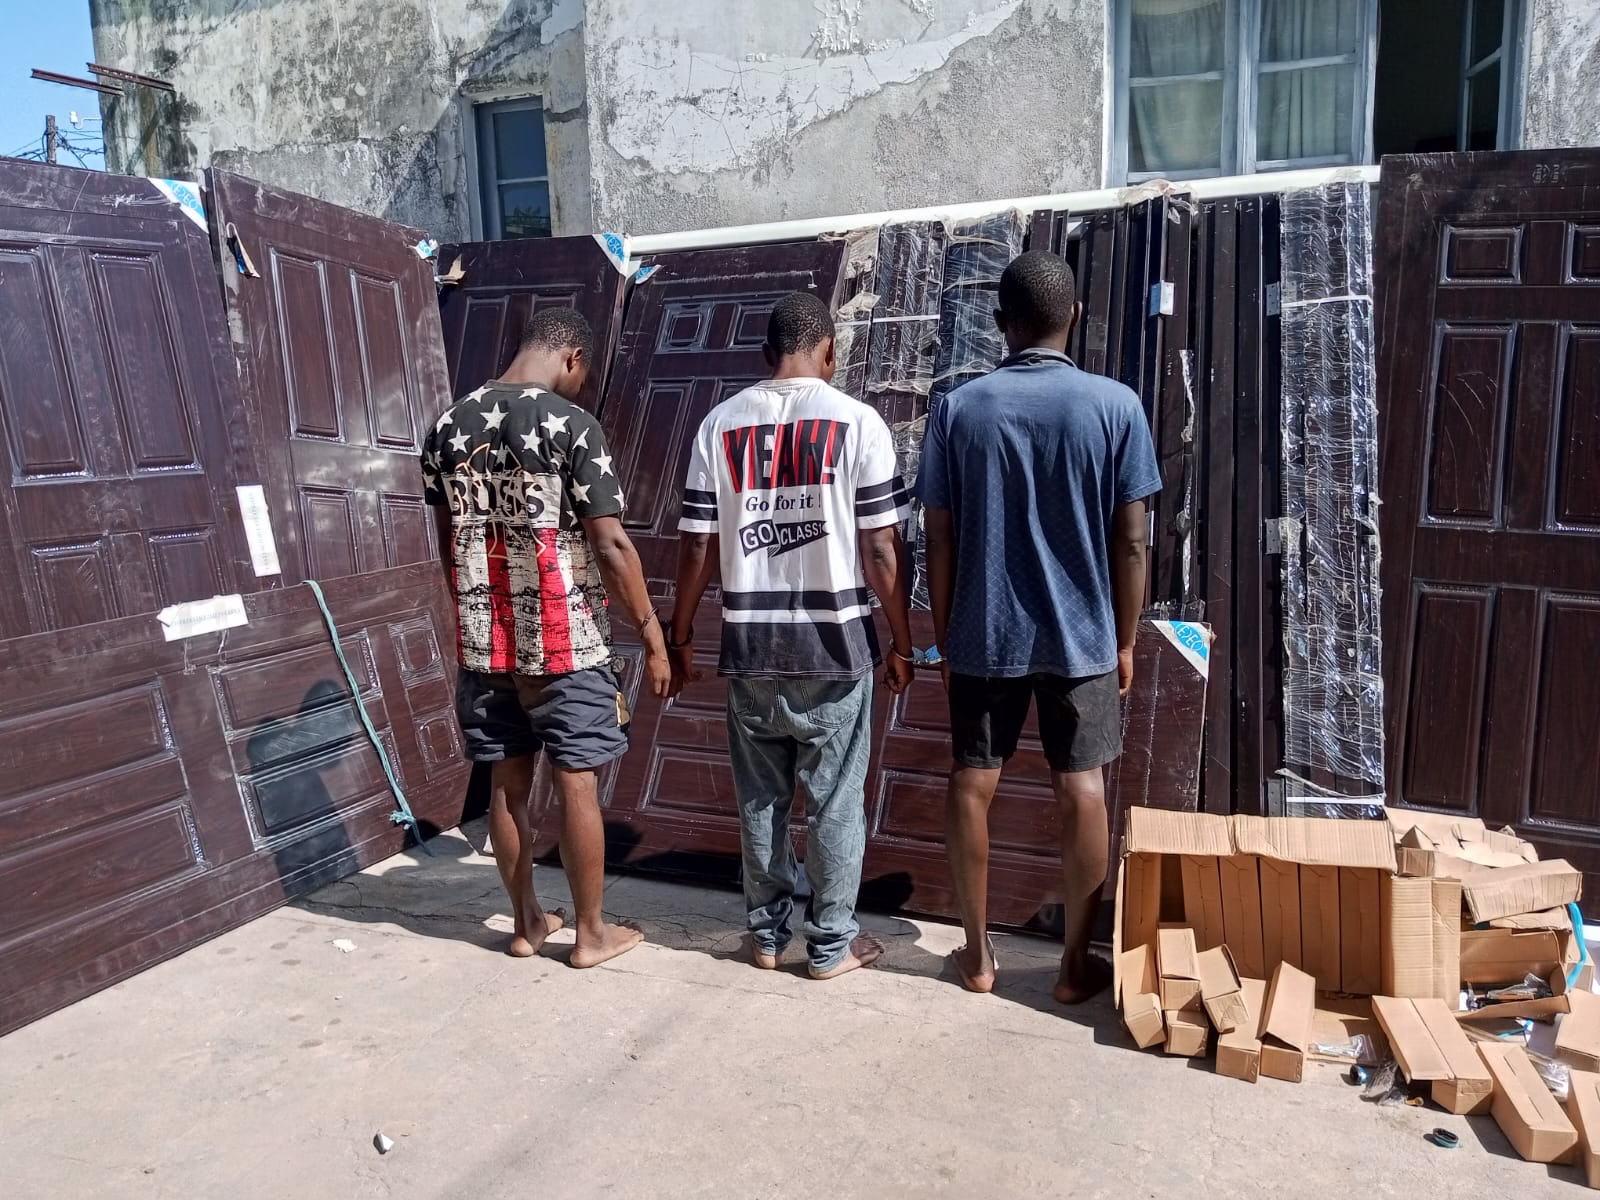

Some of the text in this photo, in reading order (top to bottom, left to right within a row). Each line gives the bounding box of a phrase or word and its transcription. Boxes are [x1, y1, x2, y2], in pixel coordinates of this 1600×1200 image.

[722, 418, 849, 493] YEAH!
[746, 496, 770, 511] Go
[774, 495, 796, 511] for
[799, 493, 813, 509] it
[742, 523, 774, 549] GO
